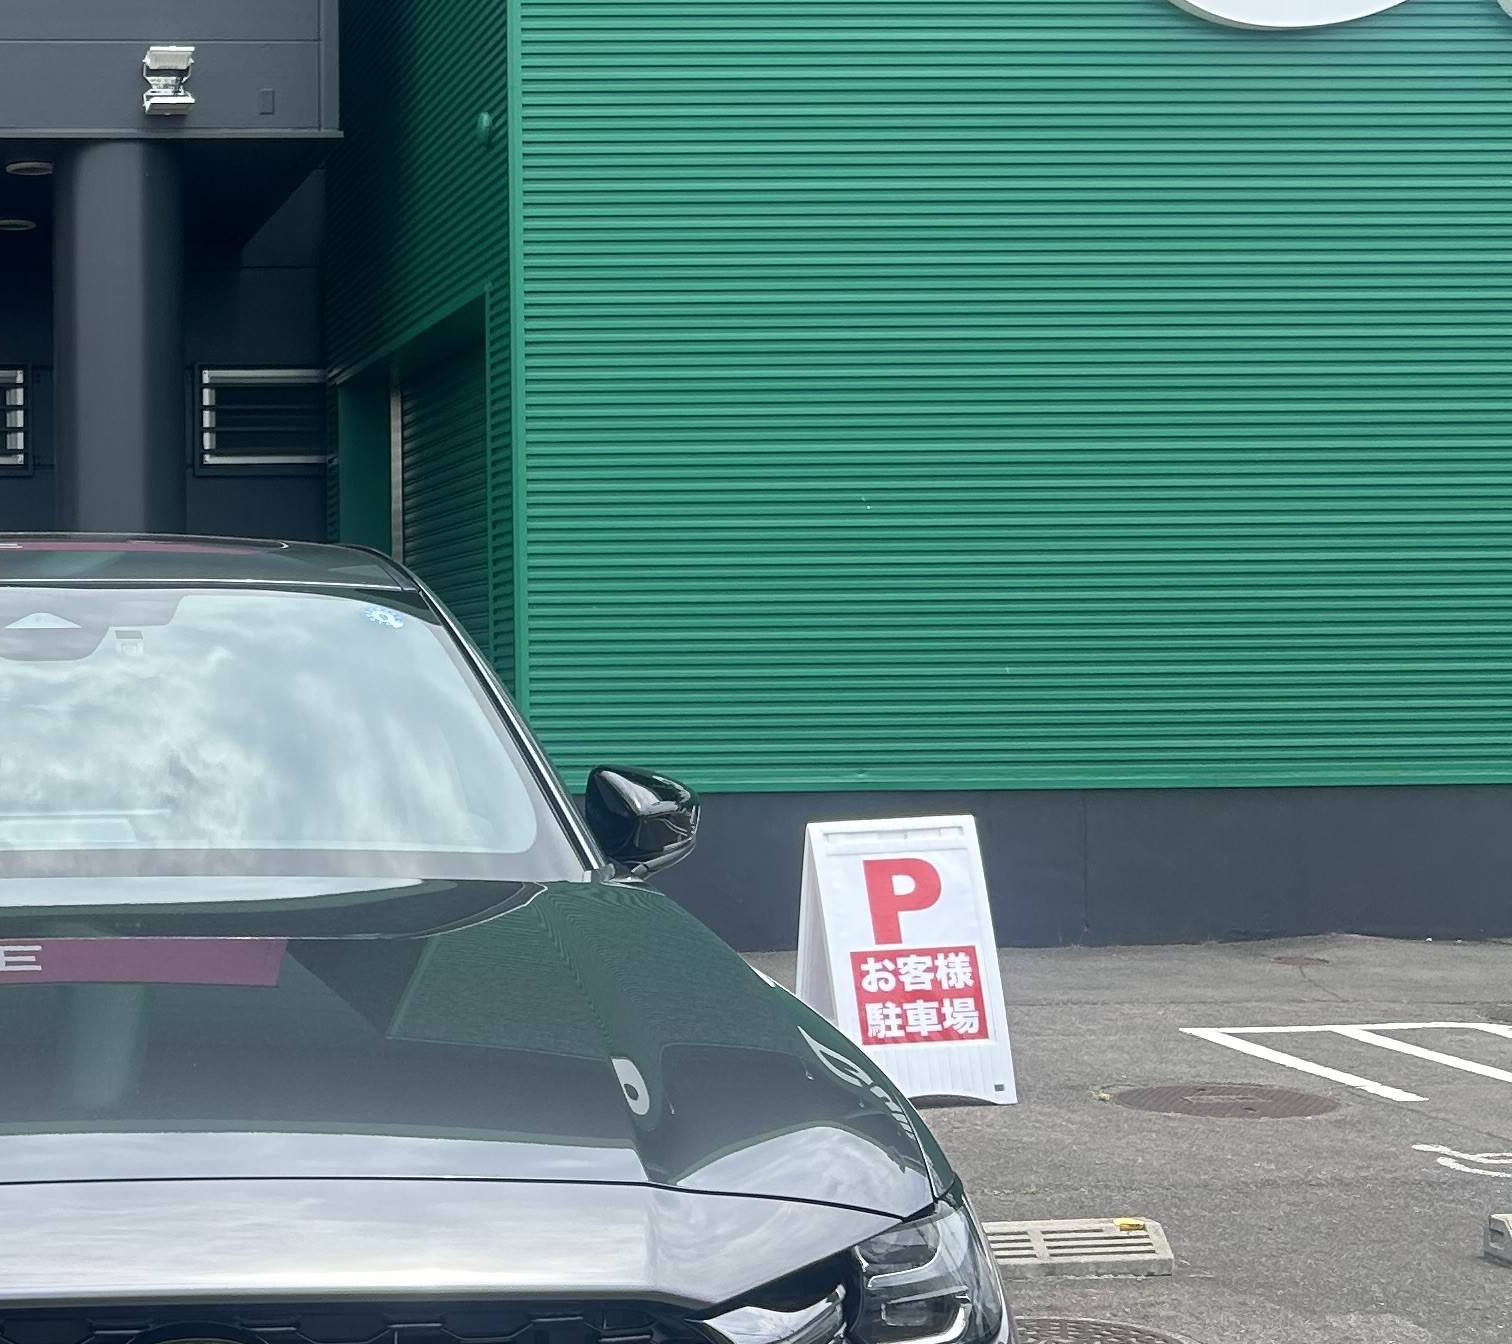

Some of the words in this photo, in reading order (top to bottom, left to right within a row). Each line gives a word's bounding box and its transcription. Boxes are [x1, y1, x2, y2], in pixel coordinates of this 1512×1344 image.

[863, 858, 942, 945] P
[860, 952, 974, 993] お客様
[864, 997, 980, 1039] 駐車場
